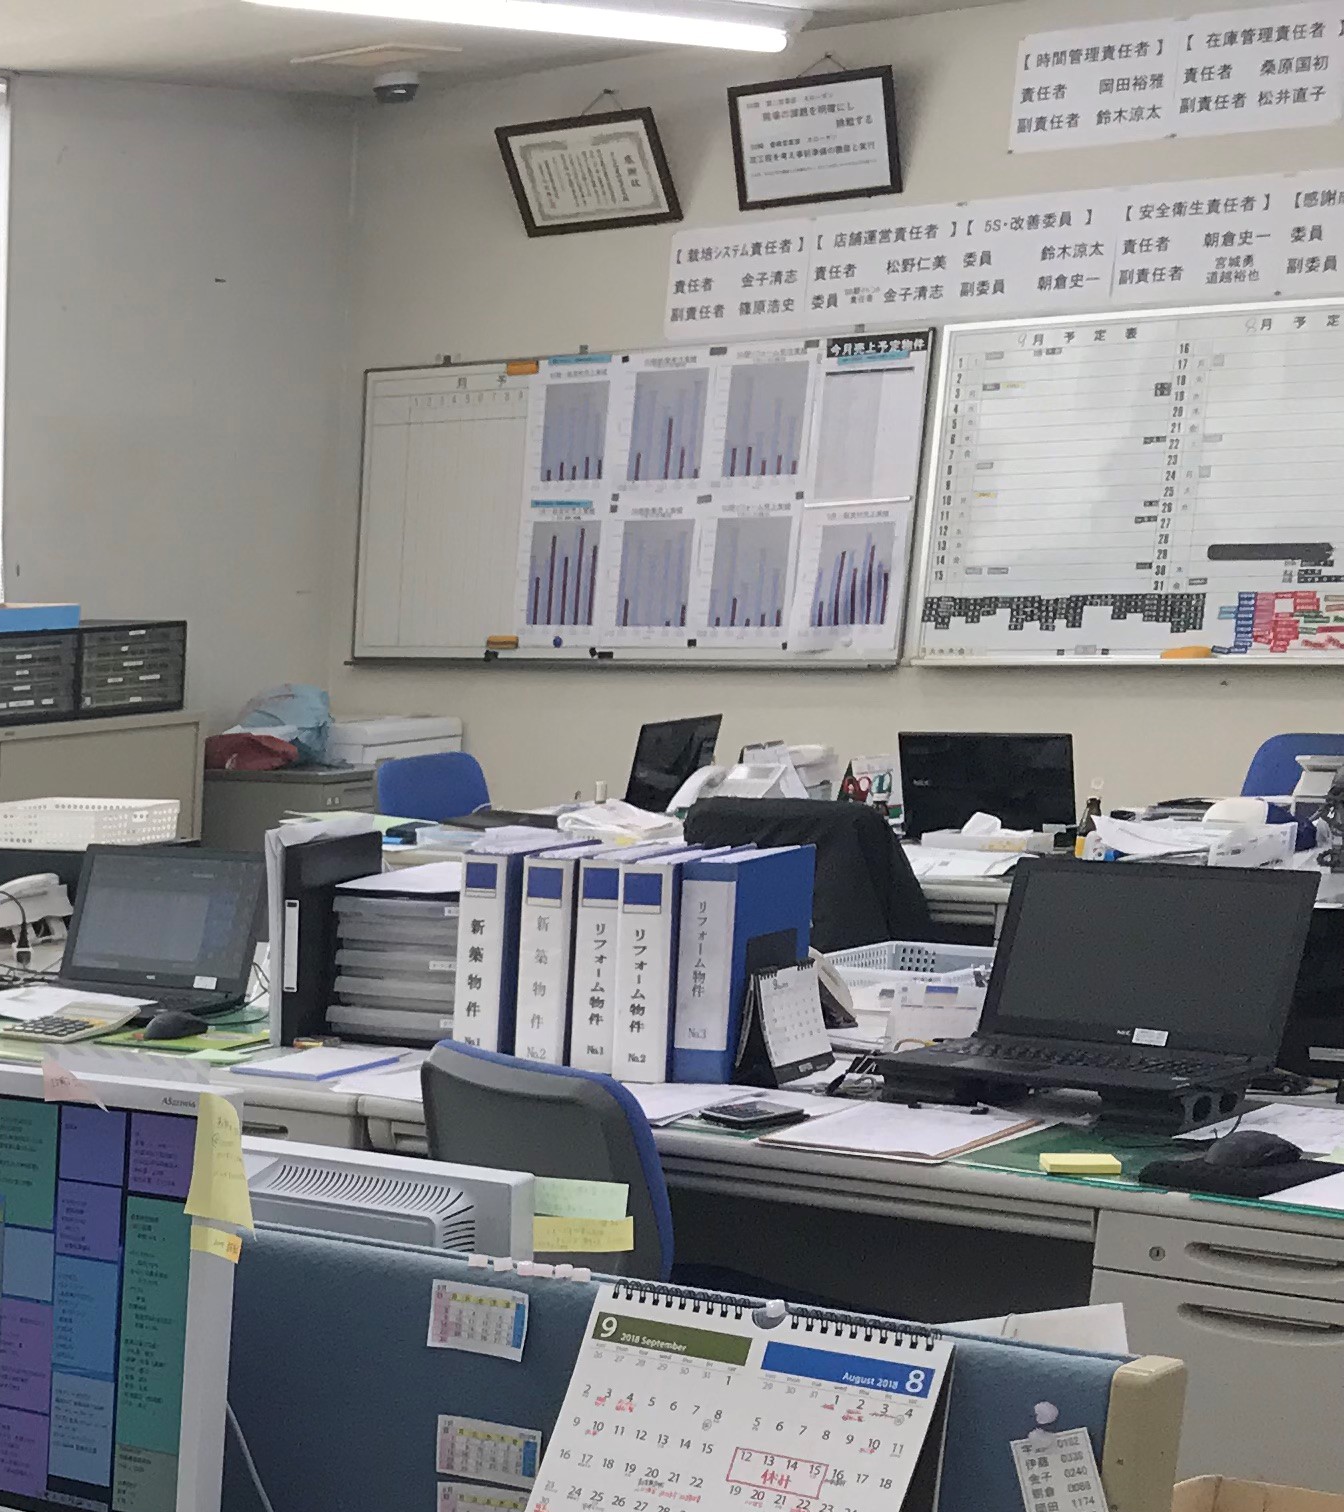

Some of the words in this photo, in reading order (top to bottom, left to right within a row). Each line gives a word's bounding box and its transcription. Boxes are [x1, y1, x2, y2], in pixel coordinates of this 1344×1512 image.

[1183, 63, 1233, 84] 責任者
[1020, 84, 1067, 104] 責任者
[1180, 92, 1246, 114] 副責任者
[1258, 85, 1326, 107] 松井直子
[1017, 113, 1080, 134] 副責任者
[1121, 237, 1170, 255] 責任者
[1203, 229, 1271, 248] 朝倉史一
[1290, 225, 1323, 243] 委員
[815, 263, 857, 281] 責任者
[886, 255, 947, 275] 松野仁美
[963, 251, 992, 268] 委員
[1287, 255, 1337, 274] 副委員
[674, 277, 713, 295] 責任者
[741, 269, 798, 288] 金子清志
[960, 279, 1005, 297] 副委員
[1037, 273, 1101, 290] 朝倉史一
[1119, 266, 1184, 286] 副責任者
[811, 293, 838, 310] 委員
[883, 283, 944, 302] 金子清志
[670, 303, 725, 322] 副責任者
[830, 338, 925, 356] 今月売上予定物件
[691, 901, 708, 999] リフォーム物件
[465, 919, 486, 1017] 新築物件
[529, 915, 551, 1029] 新築物件
[588, 923, 608, 1026] リフォーム物件
[629, 929, 647, 1033] リフォーム物件
[601, 1316, 618, 1338] 9
[621, 1332, 639, 1344] 2018
[642, 1336, 686, 1351] September
[726, 1376, 731, 1385] 1
[842, 1372, 874, 1385] August
[876, 1378, 898, 1389] 2018
[905, 1369, 925, 1393] 8
[584, 1385, 591, 1394] 2
[605, 1388, 612, 1398] 3
[626, 1393, 634, 1402] 4
[648, 1397, 655, 1406] 5
[670, 1401, 677, 1411] 6
[693, 1406, 700, 1415] 7
[714, 1410, 723, 1420] 8
[834, 1395, 840, 1404] 1
[857, 1399, 864, 1409] 2
[881, 1404, 889, 1414] 3
[905, 1409, 913, 1419] 4
[573, 1417, 580, 1427] 9
[593, 1421, 604, 1431] 10
[614, 1425, 625, 1435] 11
[635, 1430, 647, 1441] 12
[658, 1434, 669, 1445] 13
[680, 1439, 691, 1449] 14
[702, 1443, 713, 1454] 15
[754, 1417, 761, 1427] 5
[776, 1421, 784, 1431] 6
[799, 1425, 808, 1435] 7
[822, 1430, 830, 1440] 8
[846, 1435, 854, 1444] 9
[869, 1439, 881, 1450] 10
[892, 1443, 904, 1453] 11
[560, 1449, 571, 1459] 16
[581, 1454, 593, 1464] 17
[603, 1458, 614, 1469] 18
[625, 1463, 636, 1473] 19
[645, 1467, 659, 1478] 20
[668, 1472, 680, 1483] 21
[689, 1476, 703, 1488] 22
[741, 1451, 753, 1462] 12
[763, 1455, 775, 1466] 13
[786, 1460, 798, 1471] 14
[809, 1464, 821, 1475] 15
[832, 1469, 844, 1479] 16
[856, 1473, 869, 1483] 17
[879, 1478, 892, 1489] 18
[1028, 1472, 1052, 1485] 金子
[569, 1486, 581, 1497] 24
[590, 1491, 604, 1501] 25
[612, 1496, 626, 1507] 26
[634, 1501, 648, 1511] 27
[730, 1485, 742, 1495] 19
[751, 1490, 765, 1500] 20
[774, 1494, 786, 1505] 21
[796, 1499, 810, 1510] 22
[1072, 1497, 1095, 1508] 1174
